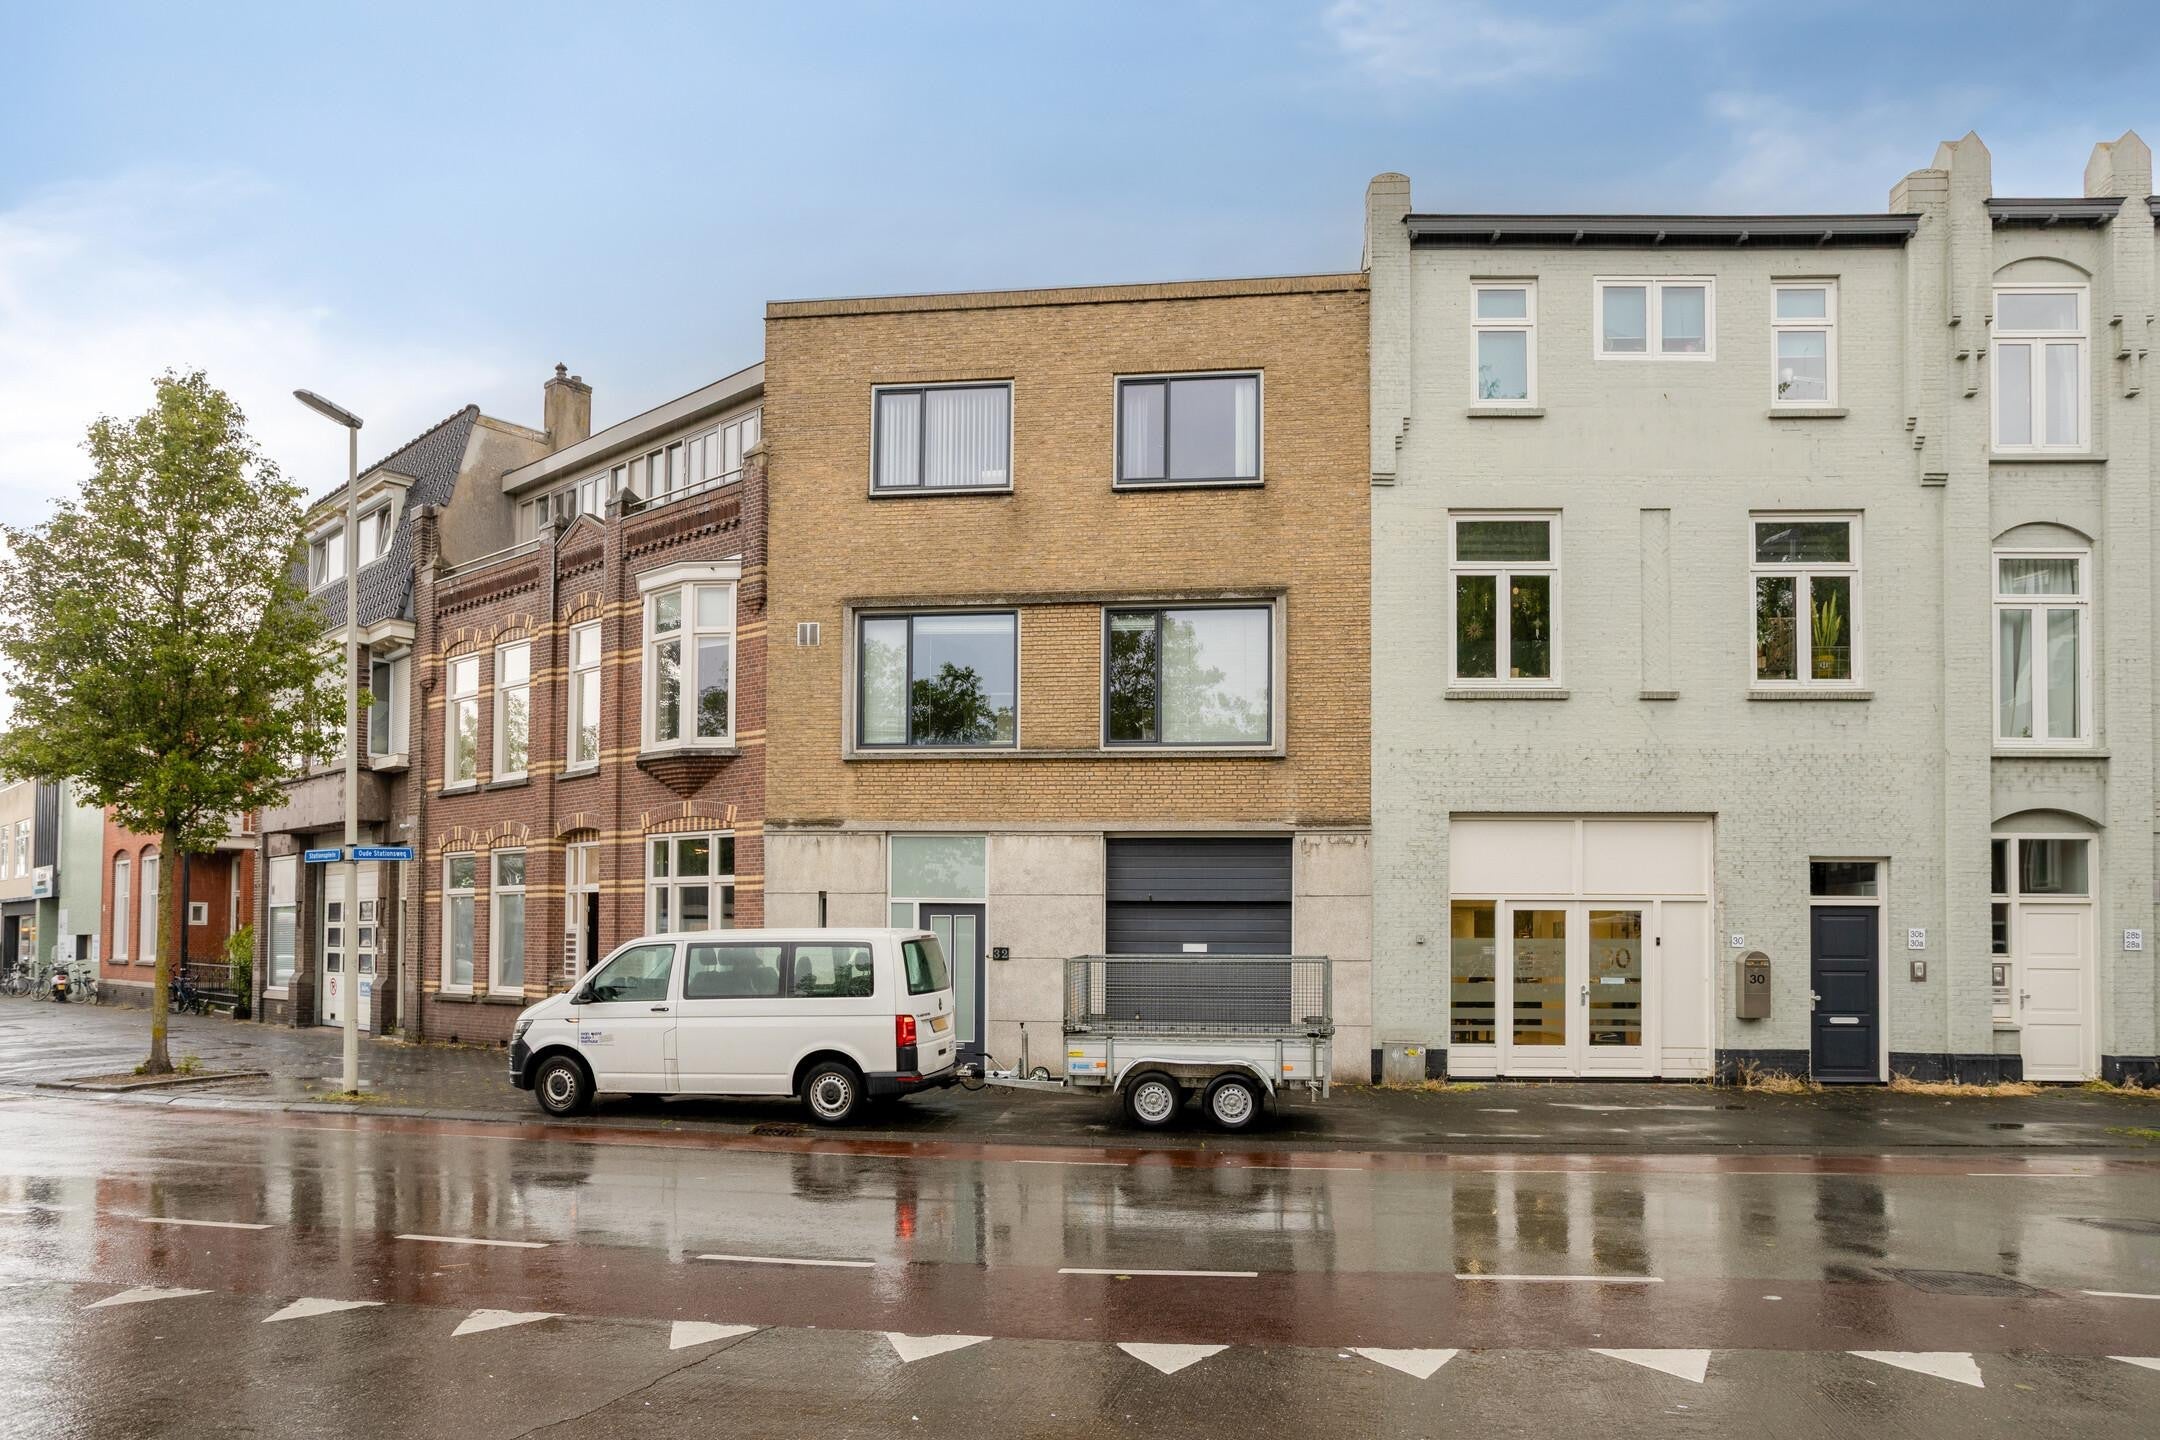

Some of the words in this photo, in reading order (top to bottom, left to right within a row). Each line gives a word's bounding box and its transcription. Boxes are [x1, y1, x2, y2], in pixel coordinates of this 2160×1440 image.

[373, 850, 407, 858] Stationsweg
[1910, 930, 1924, 938] 30b
[1732, 936, 1744, 945] 30
[993, 949, 1008, 959] 32
[1599, 945, 1632, 970] 30
[1749, 974, 1766, 985] 30
